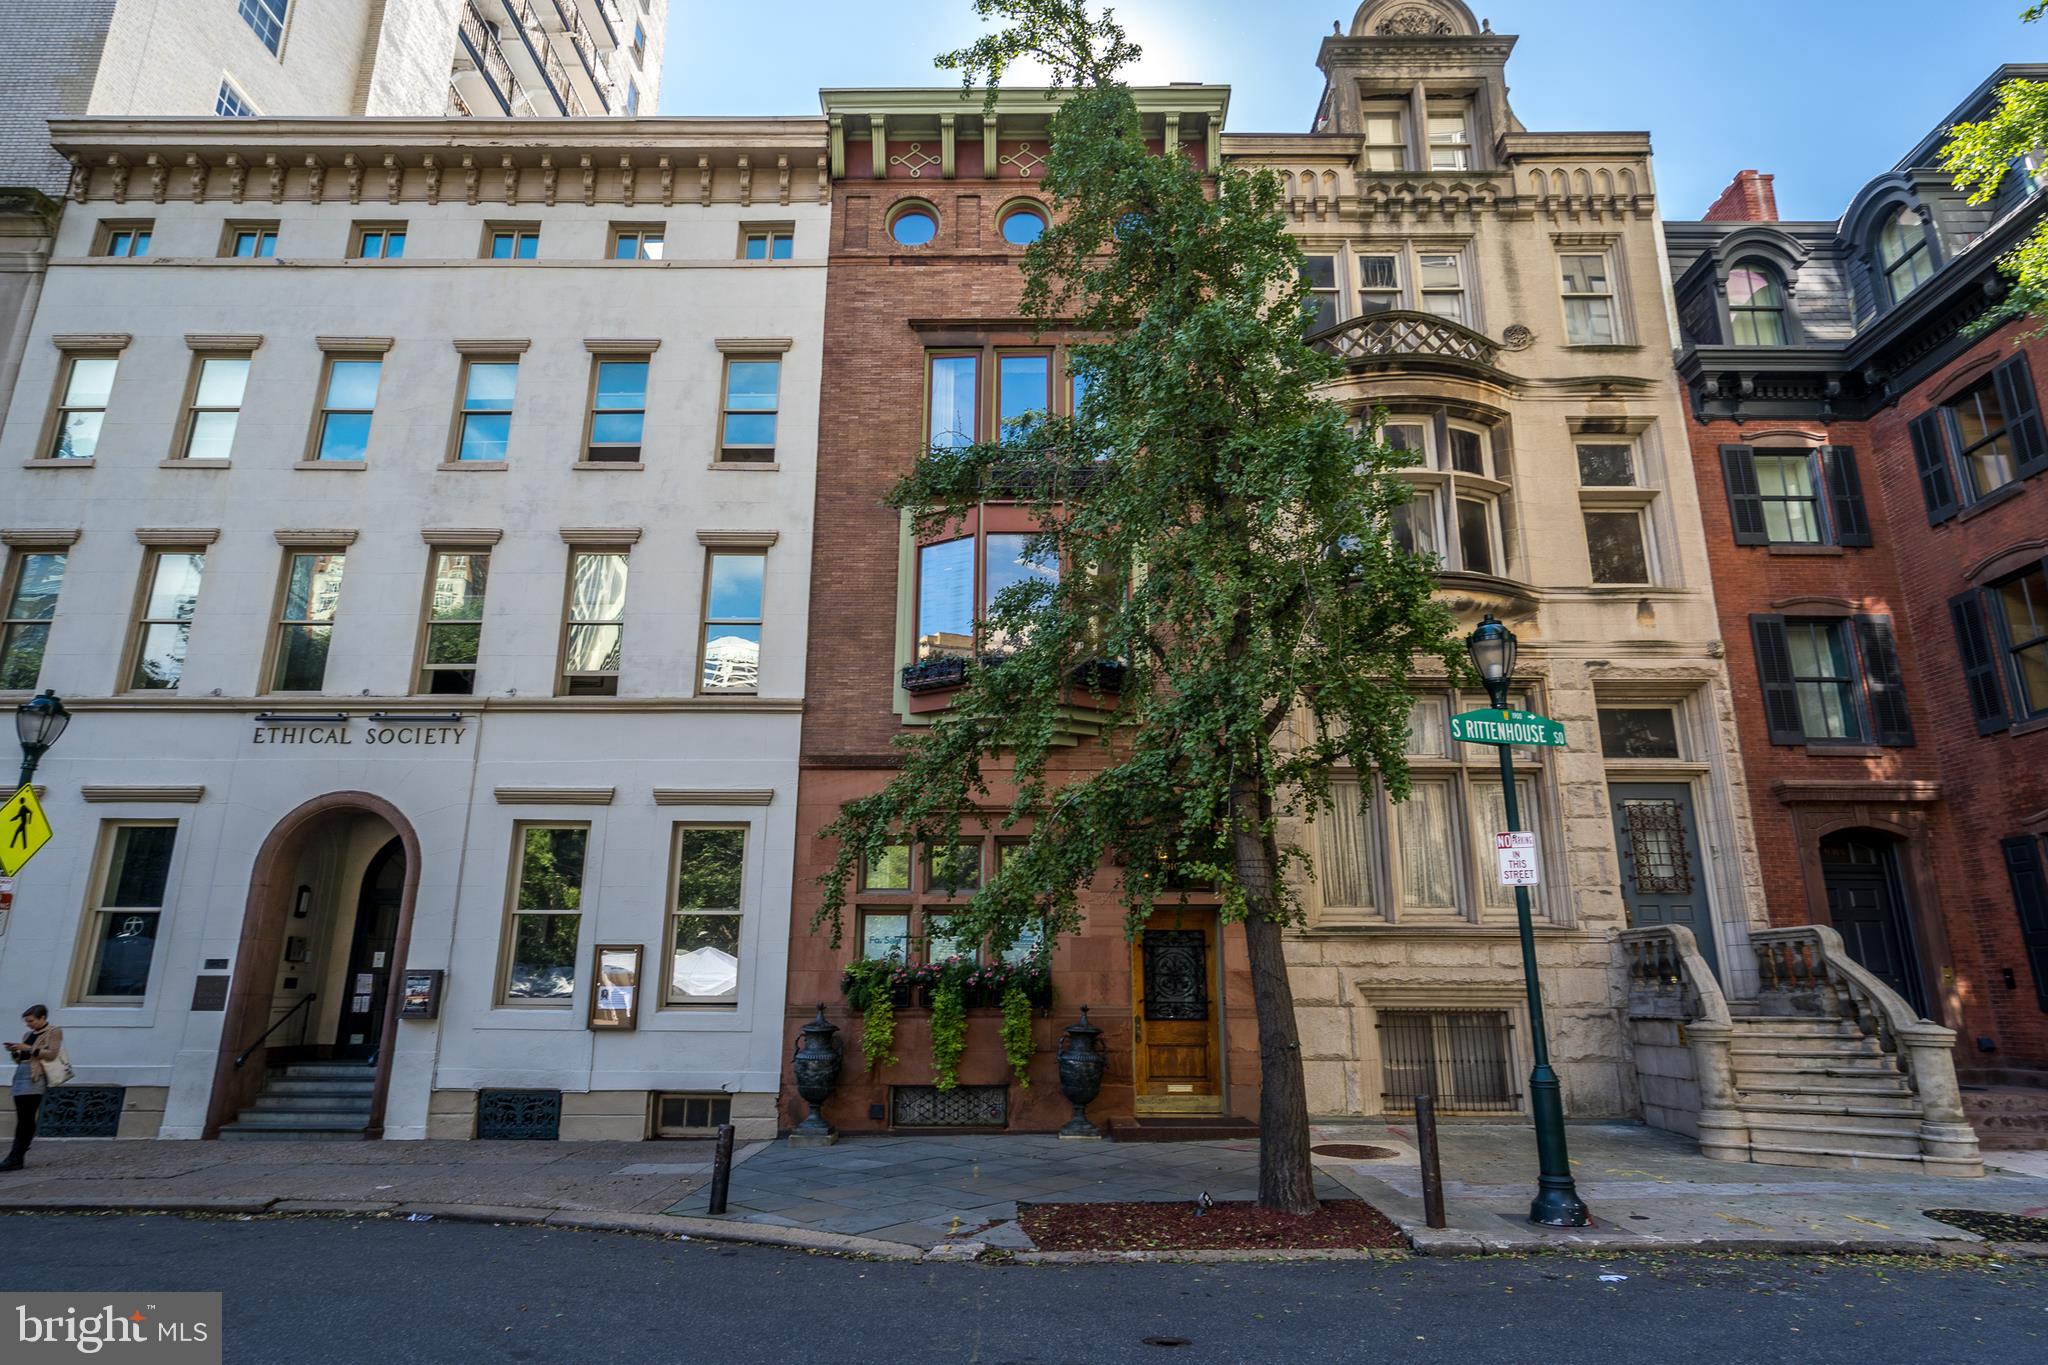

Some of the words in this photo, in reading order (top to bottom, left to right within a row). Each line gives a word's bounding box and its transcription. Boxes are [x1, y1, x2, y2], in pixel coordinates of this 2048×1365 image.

[252, 727, 352, 745] ETHICAL
[365, 727, 466, 745] SOCIETY
[1452, 719, 1461, 738] S
[1465, 720, 1547, 742] RITTENHOUSE
[1553, 731, 1565, 745] SQ
[1497, 834, 1511, 848] NO
[1512, 850, 1520, 858] IN
[1508, 859, 1527, 868] THIS
[1503, 869, 1534, 879] STREET
